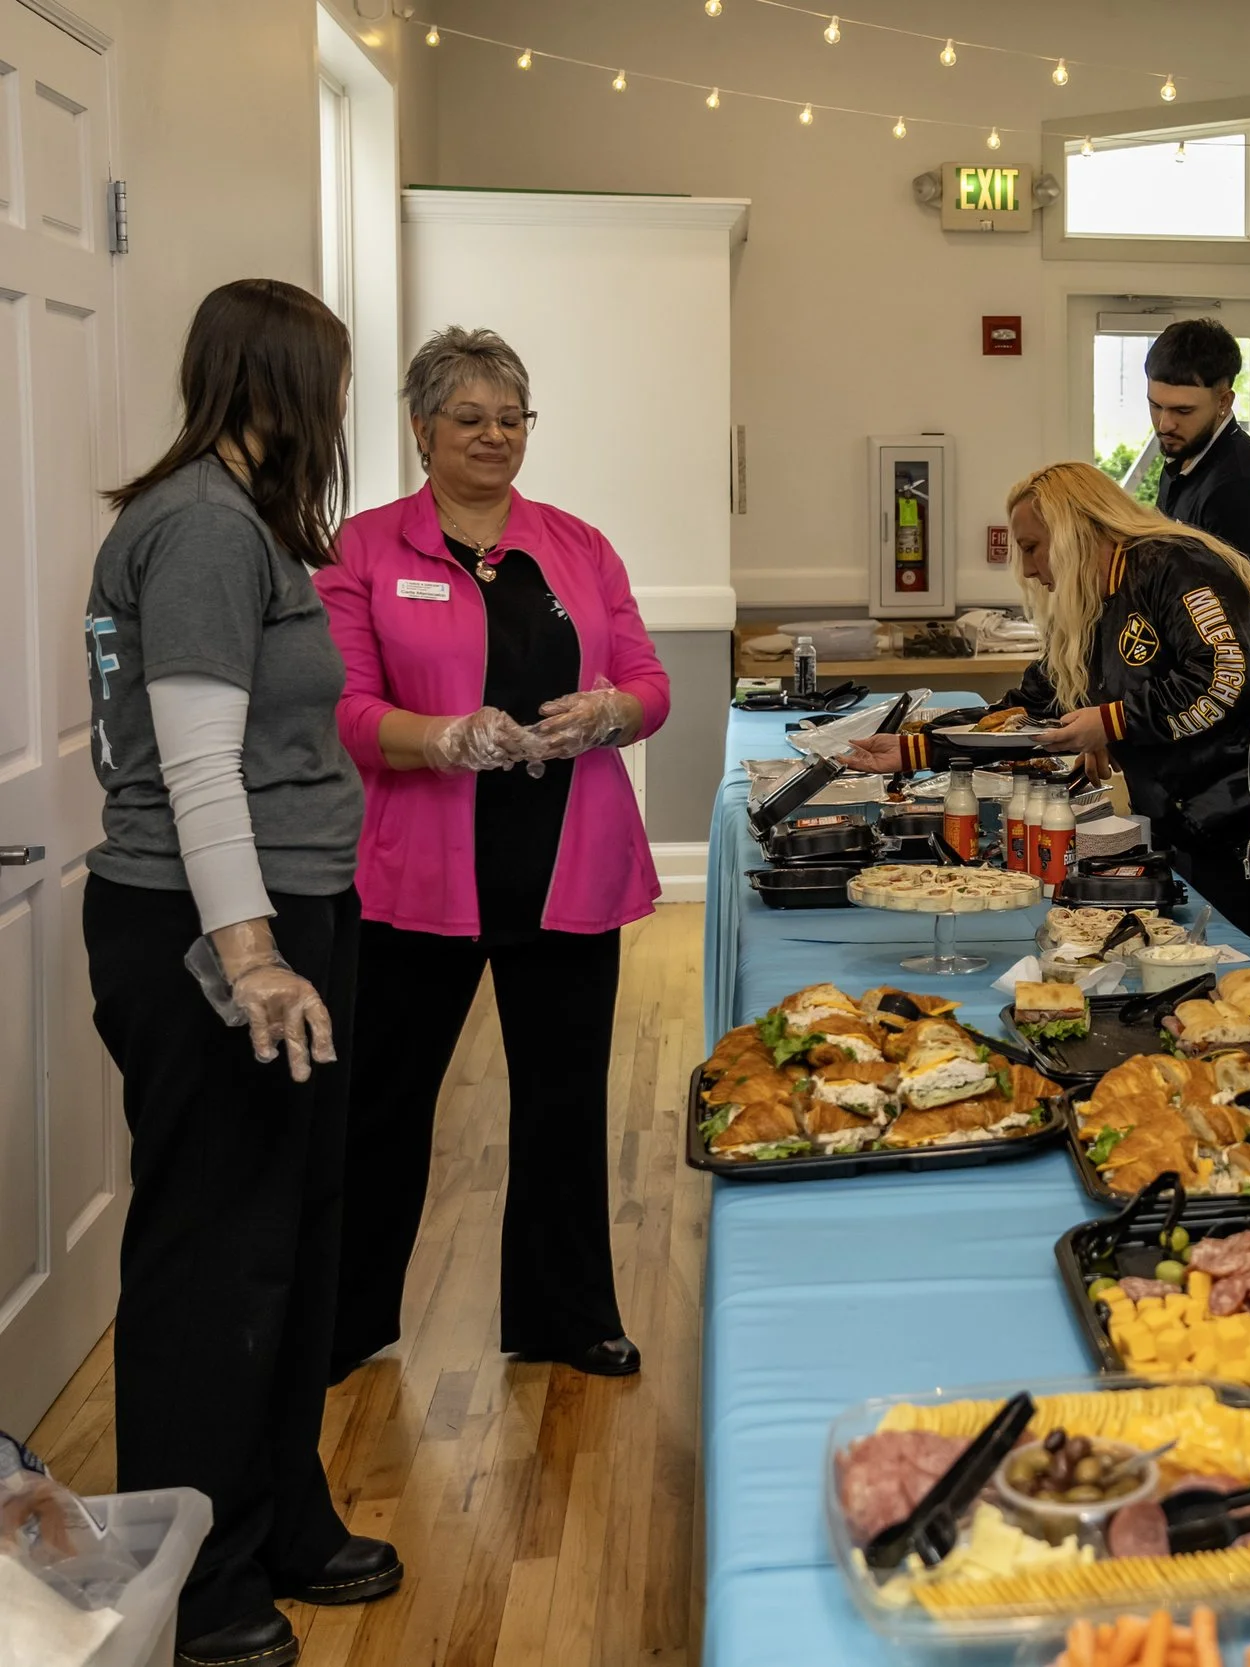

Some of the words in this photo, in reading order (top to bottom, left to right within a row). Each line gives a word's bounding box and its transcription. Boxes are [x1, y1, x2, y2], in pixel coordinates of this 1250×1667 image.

[960, 168, 1018, 210] EXIT
[992, 532, 1007, 545] FIR
[1182, 586, 1236, 646] MILE
[1208, 642, 1246, 708] HIGH
[1167, 695, 1226, 741] CITY
